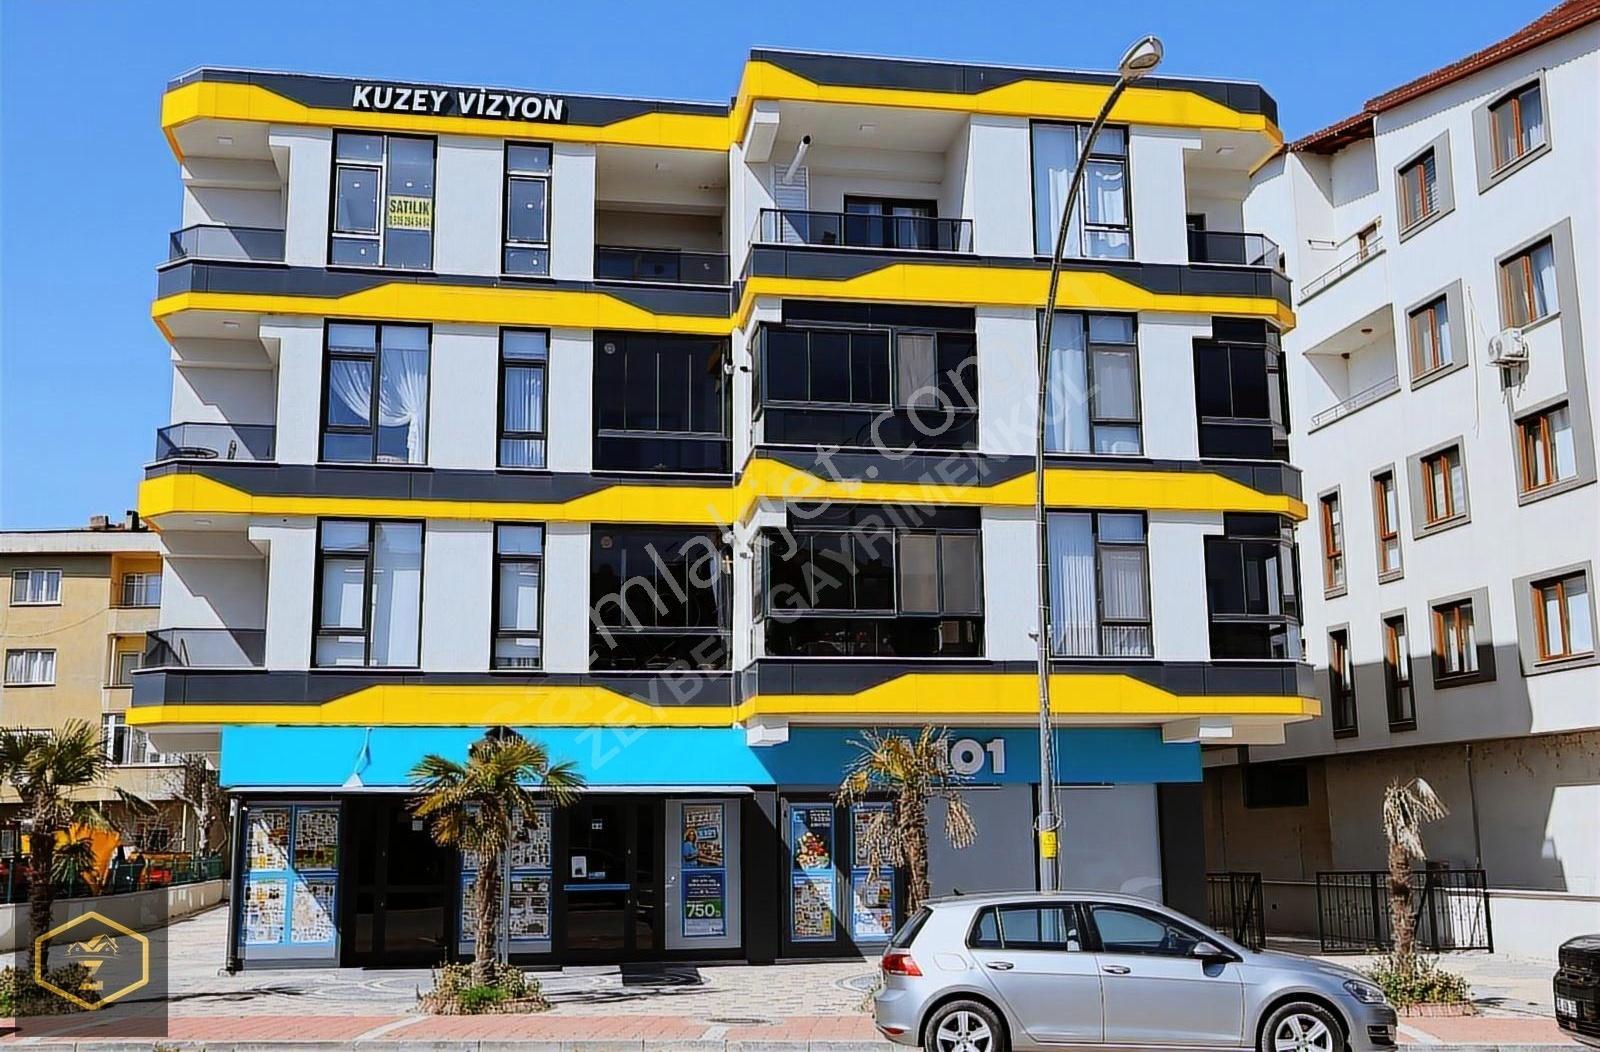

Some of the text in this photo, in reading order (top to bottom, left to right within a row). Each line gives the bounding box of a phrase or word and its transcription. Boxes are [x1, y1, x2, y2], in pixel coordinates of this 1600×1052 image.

[352, 85, 563, 120] KUZEY VİZYON
[389, 199, 430, 216] SATILIK
